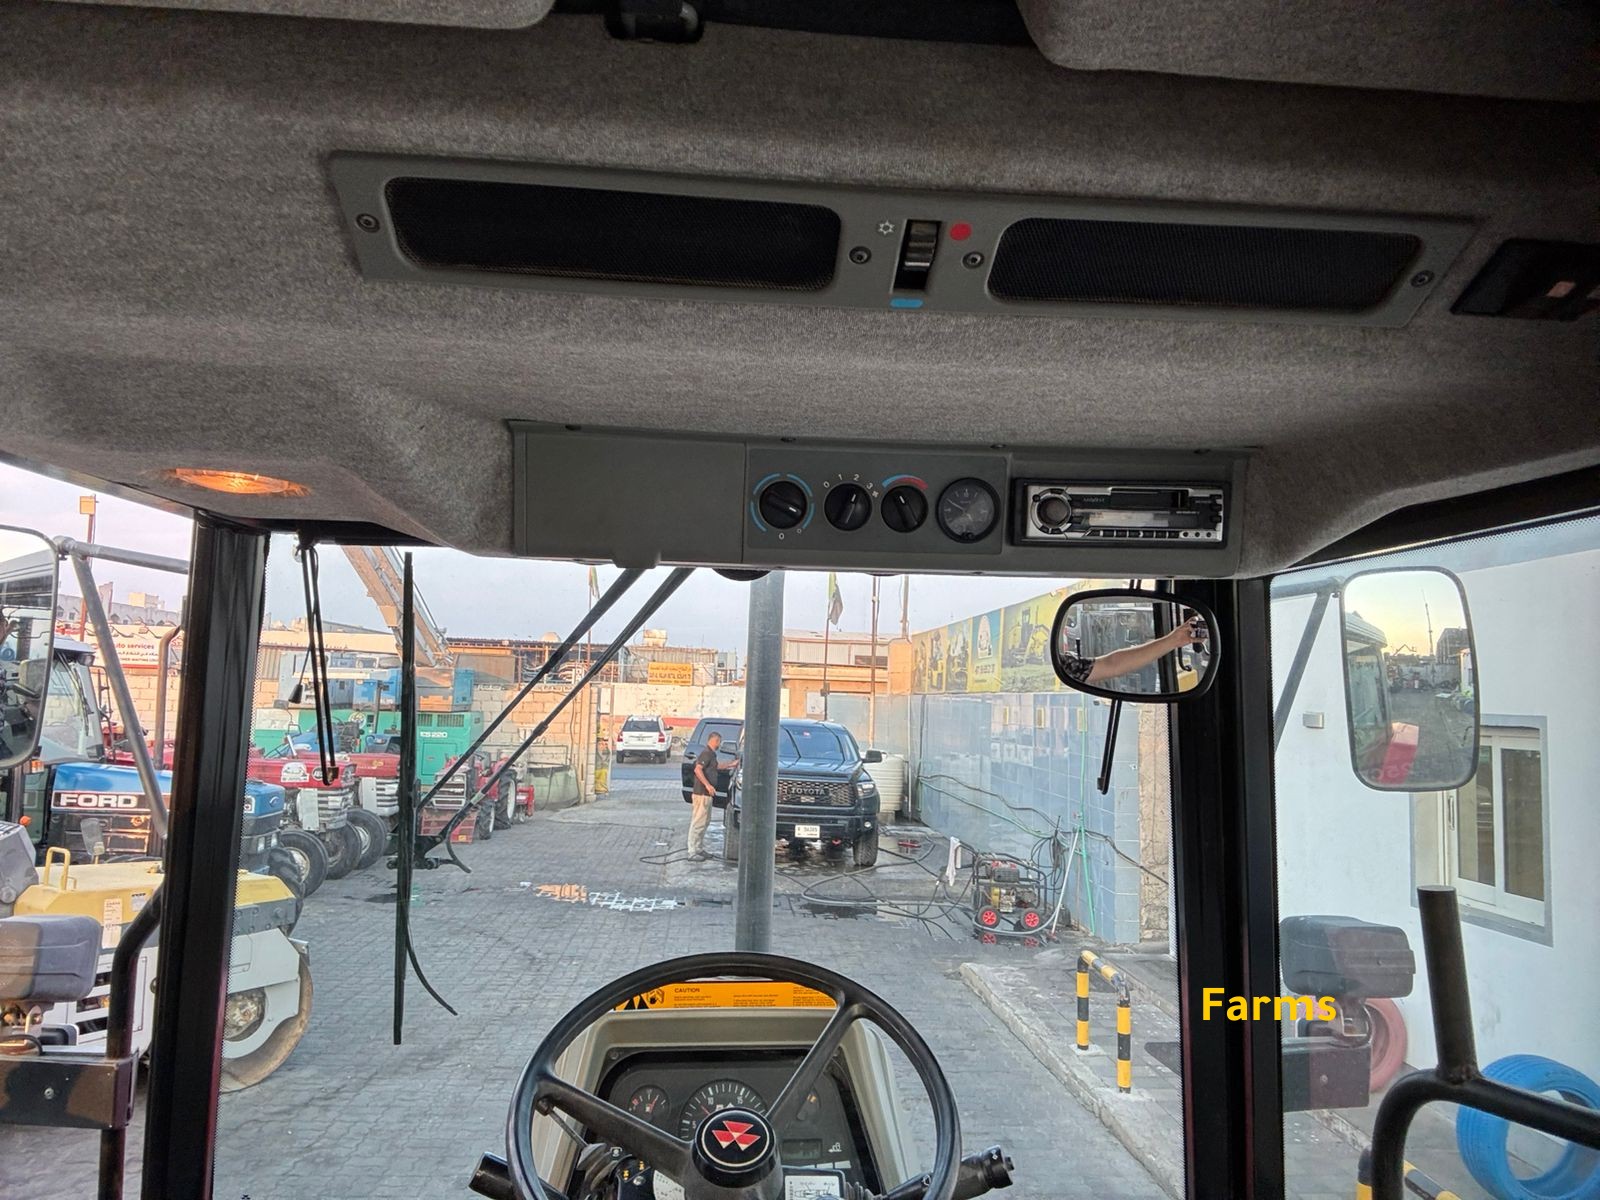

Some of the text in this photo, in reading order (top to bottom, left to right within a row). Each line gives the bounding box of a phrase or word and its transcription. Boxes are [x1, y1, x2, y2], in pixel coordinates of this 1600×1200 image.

[853, 473, 860, 481] 2
[866, 482, 874, 490] 3
[791, 787, 825, 796] TOYOTA
[60, 793, 137, 808] FORD
